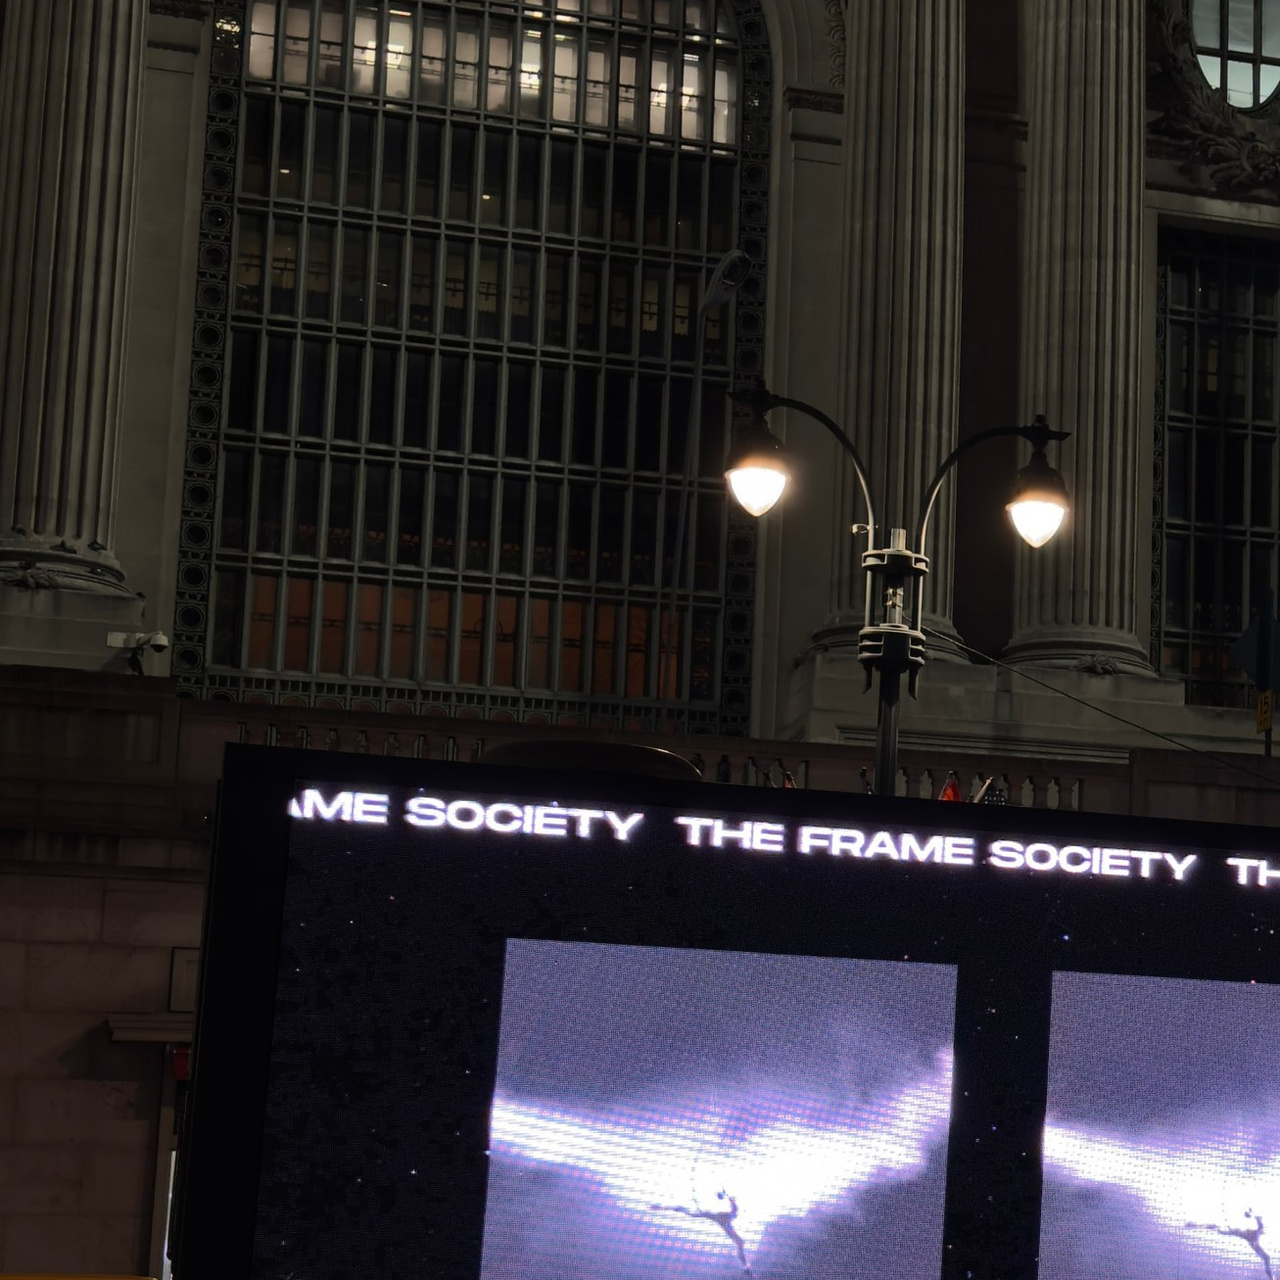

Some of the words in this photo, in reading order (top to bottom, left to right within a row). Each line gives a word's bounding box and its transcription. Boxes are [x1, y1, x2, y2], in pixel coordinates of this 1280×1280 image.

[288, 788, 390, 824] ME
[404, 796, 645, 841] SOCIETY
[674, 816, 785, 853] THE
[797, 825, 976, 866] FRAME
[987, 839, 1198, 881] SOCIETY
